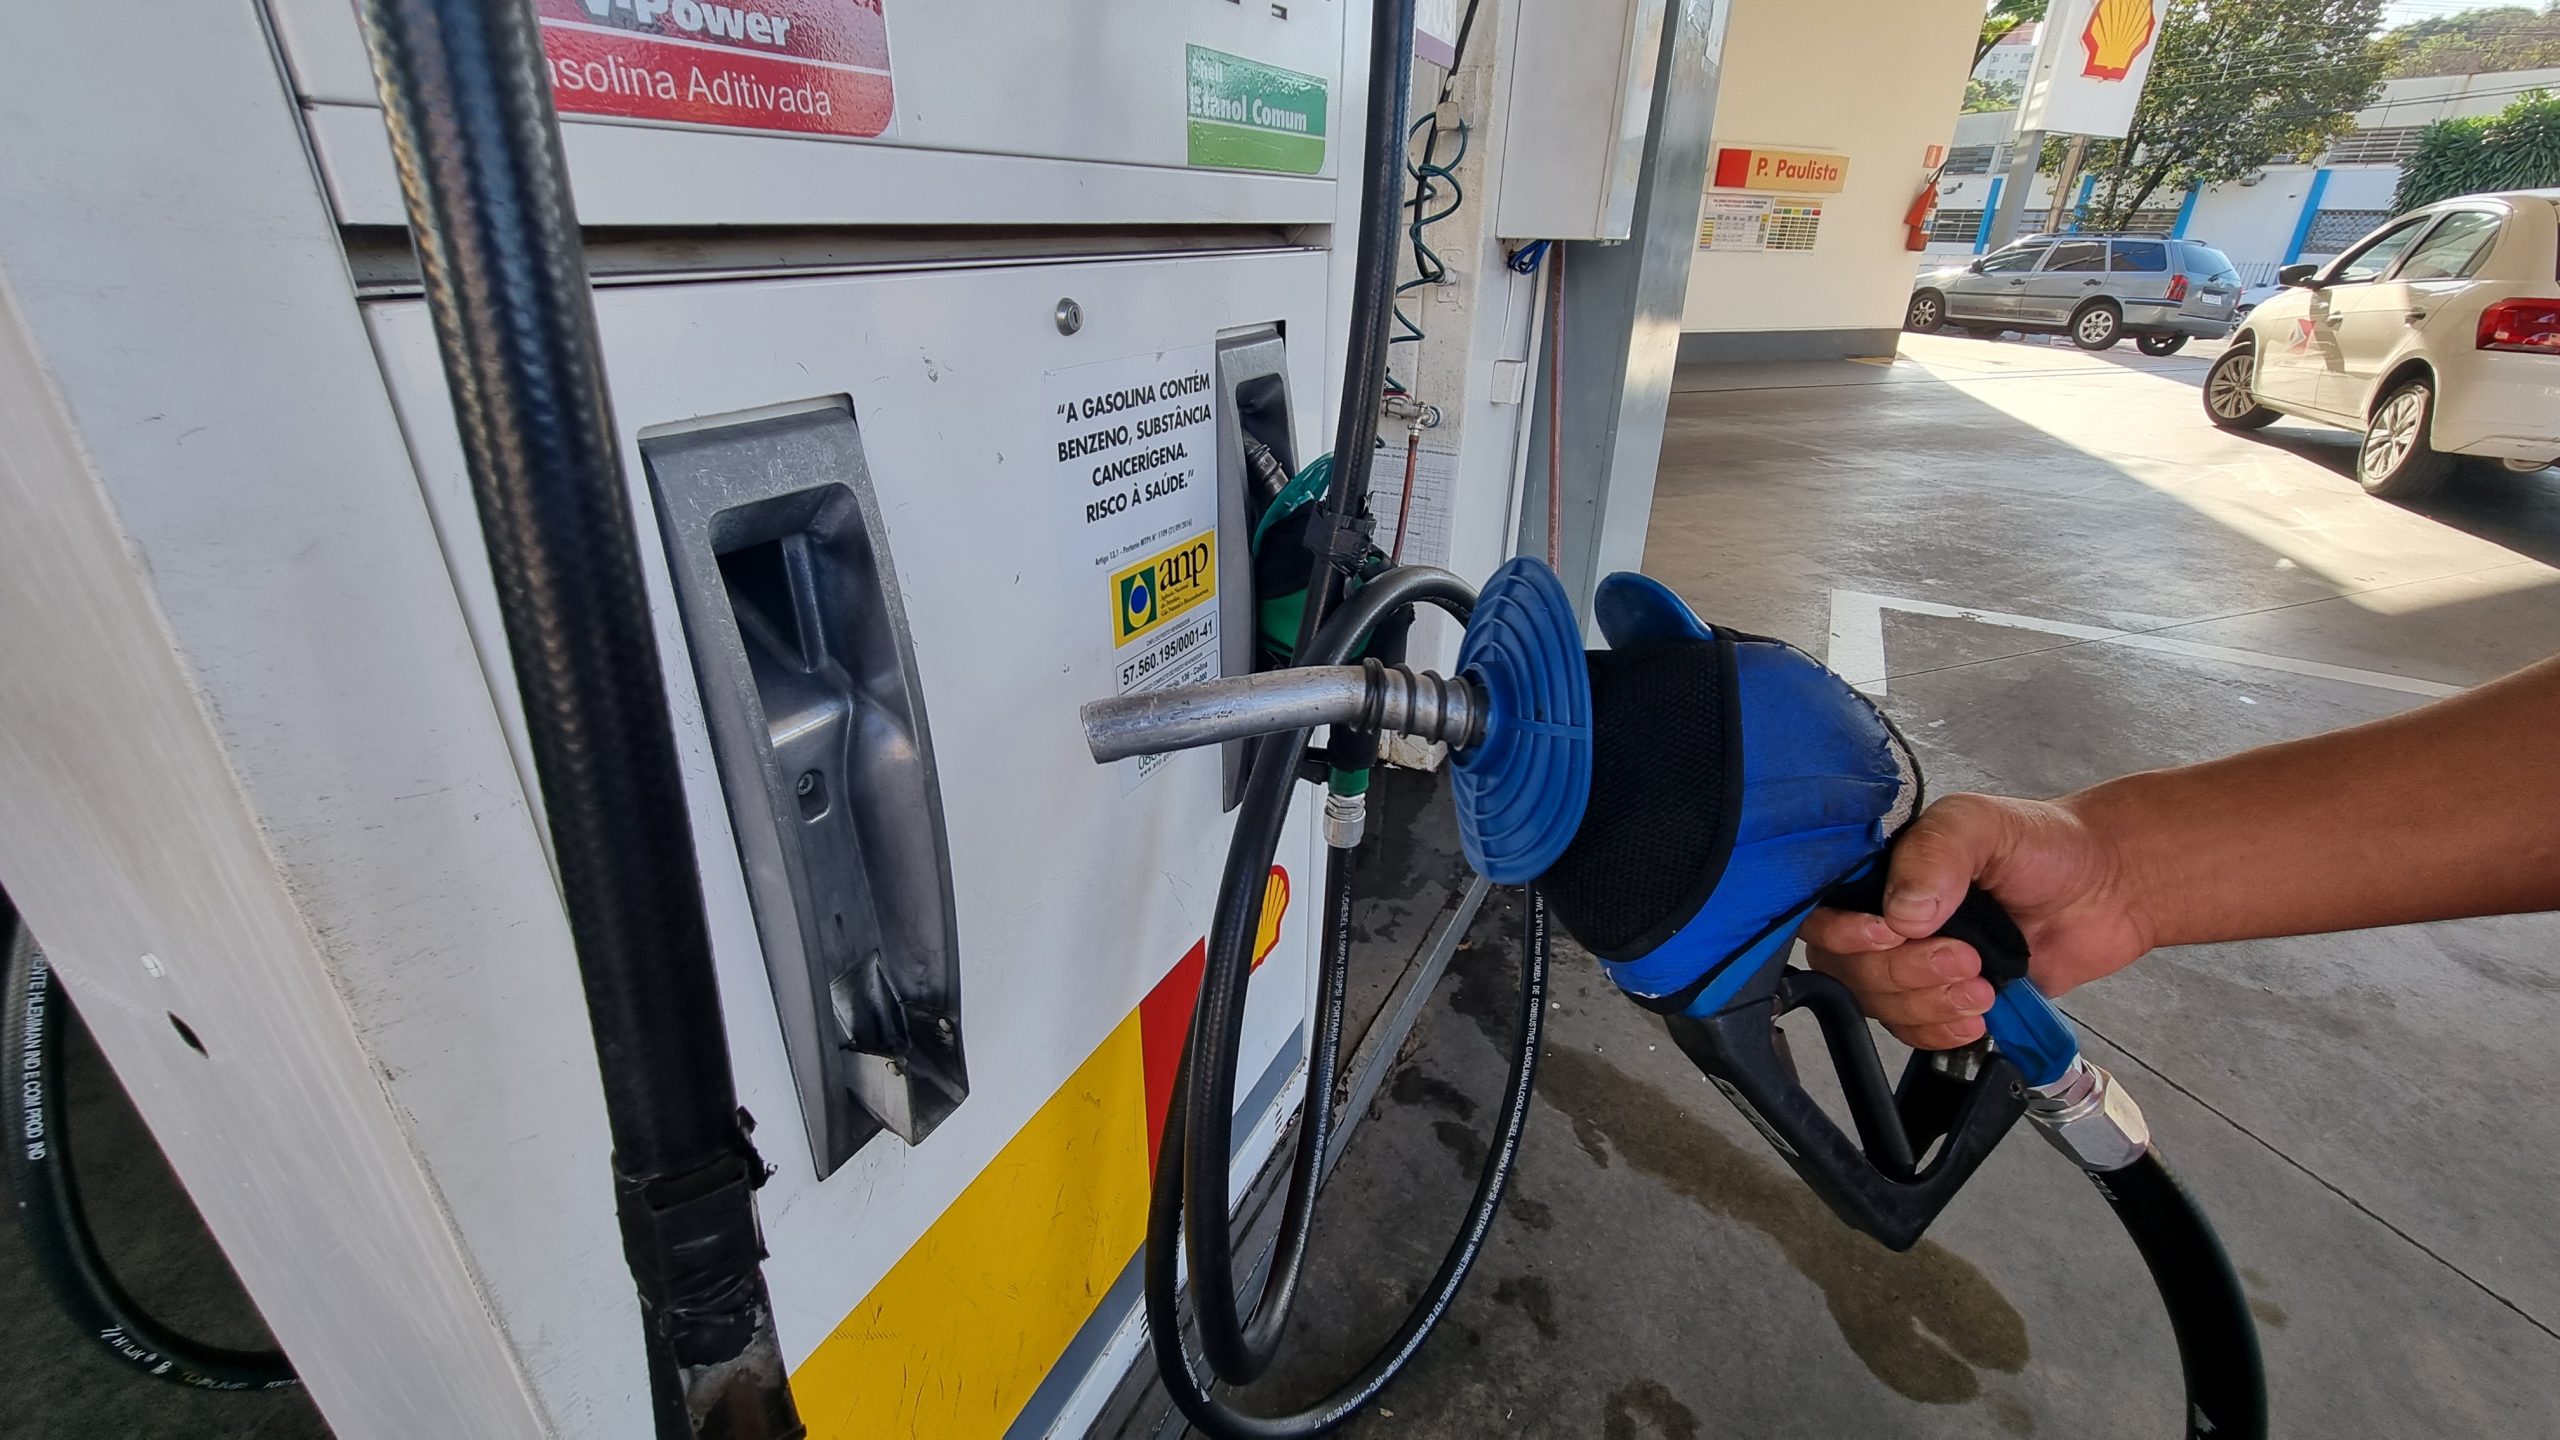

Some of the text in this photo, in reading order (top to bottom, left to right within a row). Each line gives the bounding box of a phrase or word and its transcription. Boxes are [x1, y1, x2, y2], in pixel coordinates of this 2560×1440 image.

[1192, 57, 1223, 83] Shell
[688, 66, 832, 116] Aditivada
[1190, 86, 1307, 132] Etanol Comum
[1756, 157, 1838, 181] P. Paulista
[1082, 385, 1156, 419] GASOLINA
[1159, 369, 1210, 400] CONTÉM
[1058, 404, 1212, 462] BENZENO, SUBSTÂNCIA
[1092, 442, 1188, 487] CANCERÍGENA.
[1086, 493, 1127, 524] RISCO
[1131, 482, 1142, 507] À
[1159, 543, 1209, 592] anp
[1122, 619, 1213, 686] 57.560.195/0001-41
[1532, 956, 1542, 982] BOMBA
[1531, 985, 1540, 995] DE
[1330, 1000, 1341, 1042] PORTARIA
[24, 1081, 42, 1108] COM
[24, 1107, 44, 1139] PROD
[27, 1141, 46, 1160] IND
[1471, 1202, 1493, 1242] PORTARIA
[1424, 1313, 1436, 1328] DE
